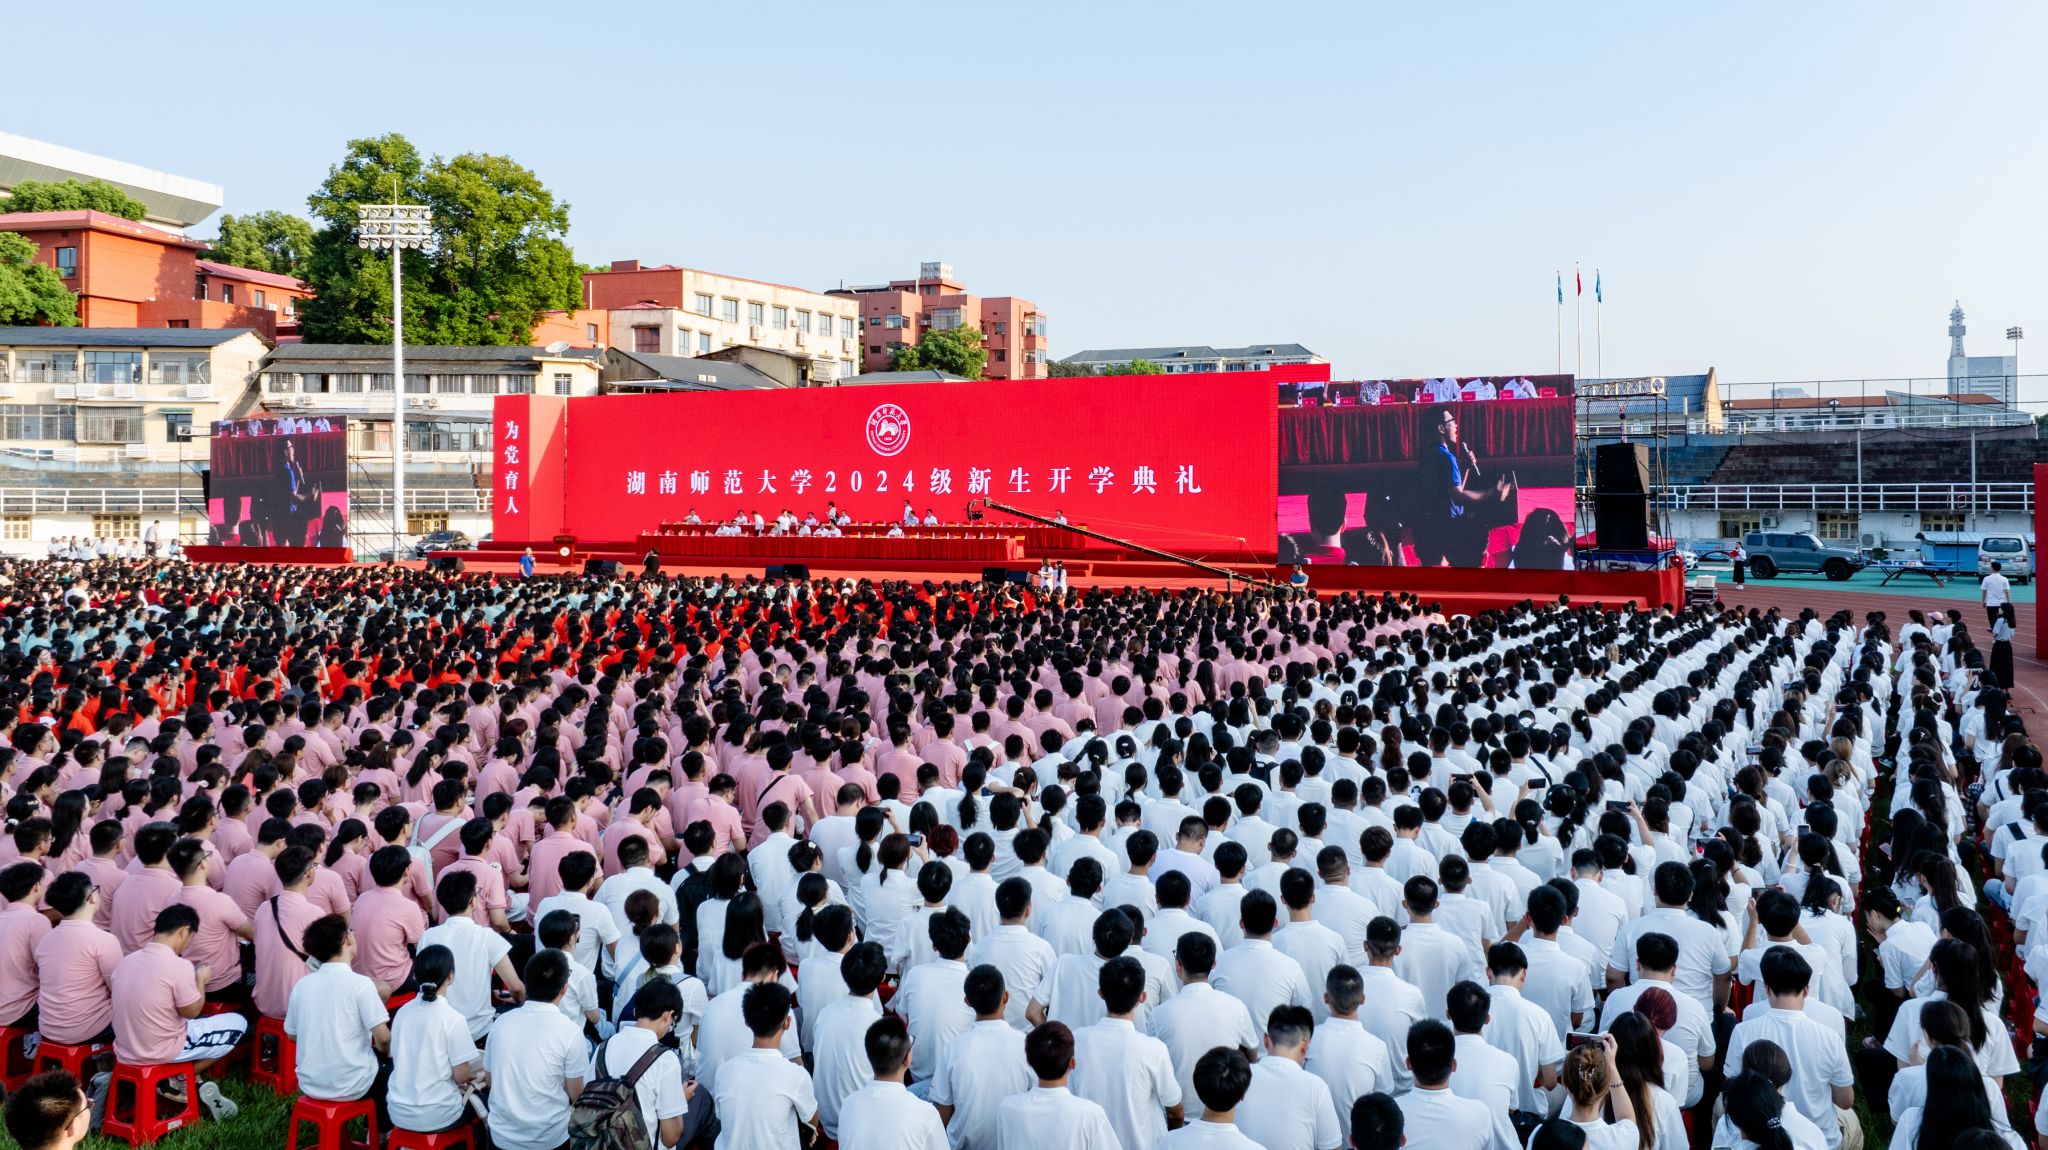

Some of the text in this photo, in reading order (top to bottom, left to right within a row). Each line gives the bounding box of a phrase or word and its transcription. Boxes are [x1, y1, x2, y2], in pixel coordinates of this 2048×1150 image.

[504, 420, 520, 514] 为党育人
[626, 465, 1202, 495] 湖南师范大学2024级新生开学典礼
